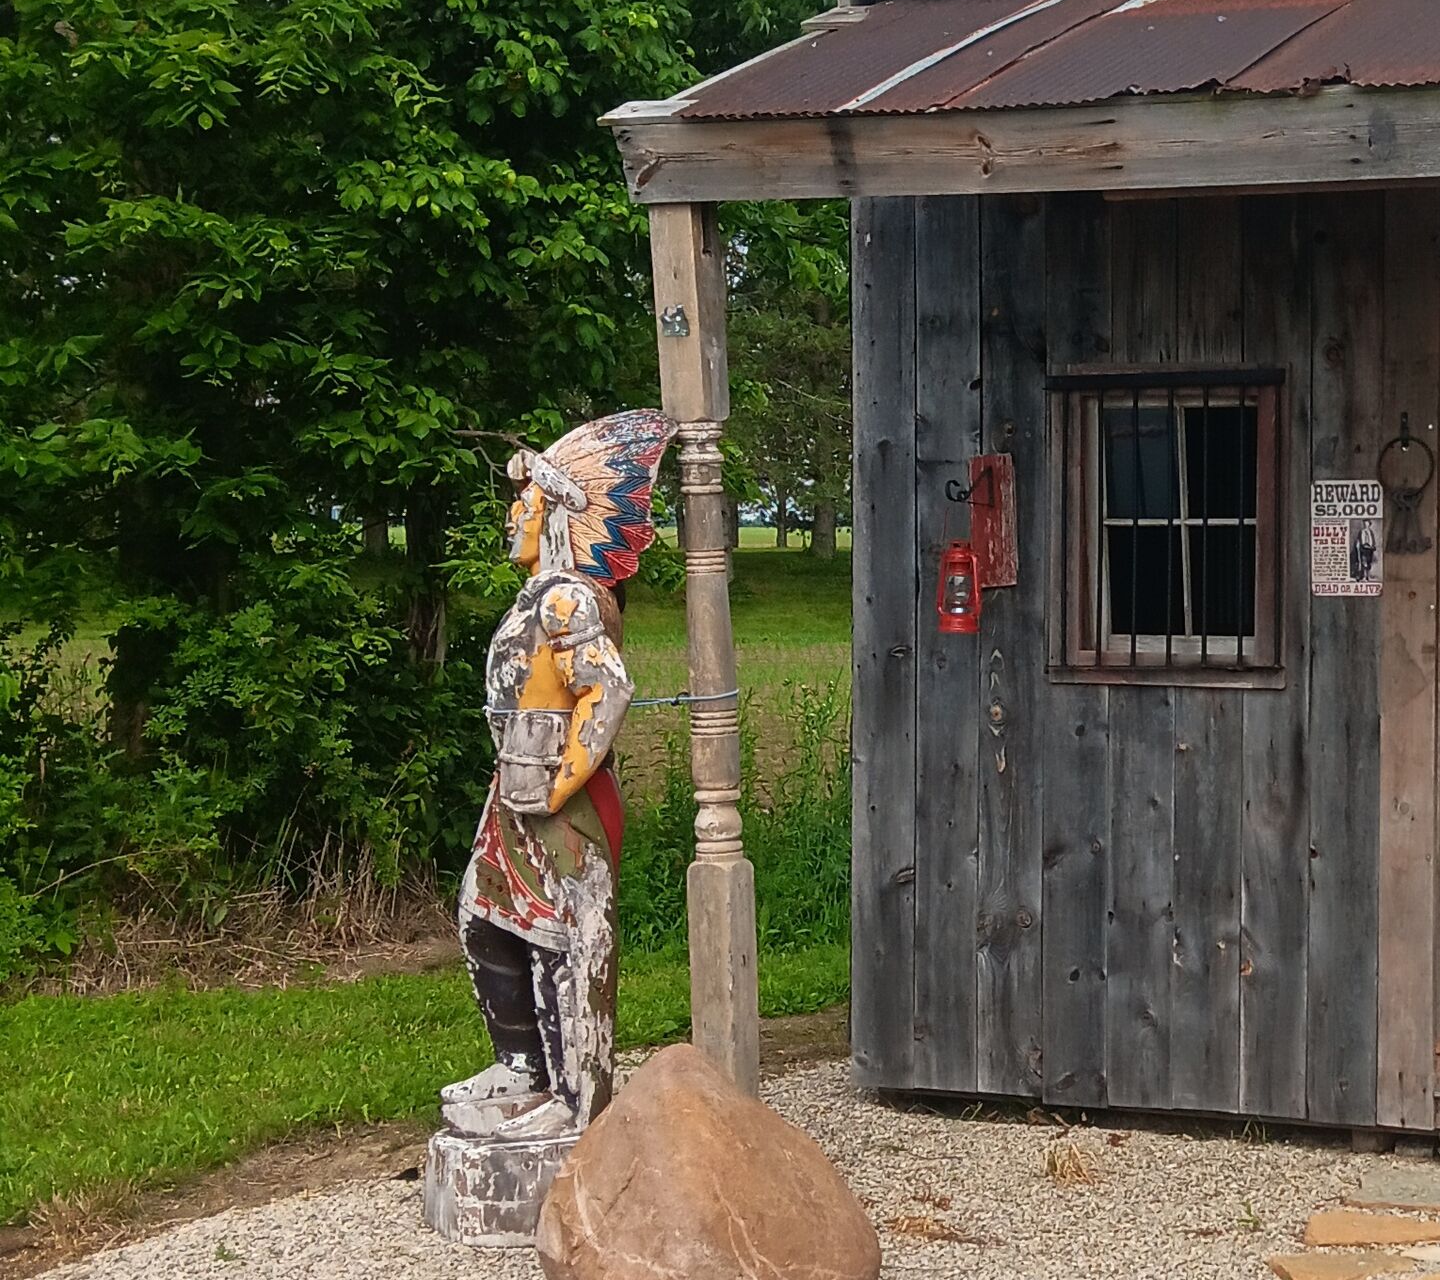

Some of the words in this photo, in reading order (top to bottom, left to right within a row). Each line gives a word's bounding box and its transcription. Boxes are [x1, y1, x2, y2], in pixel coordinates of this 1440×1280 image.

[1313, 483, 1381, 503] REWARD
[1313, 585, 1339, 594] DEAD
[1341, 585, 1352, 594] OR
[1354, 585, 1382, 594] ALIVE
